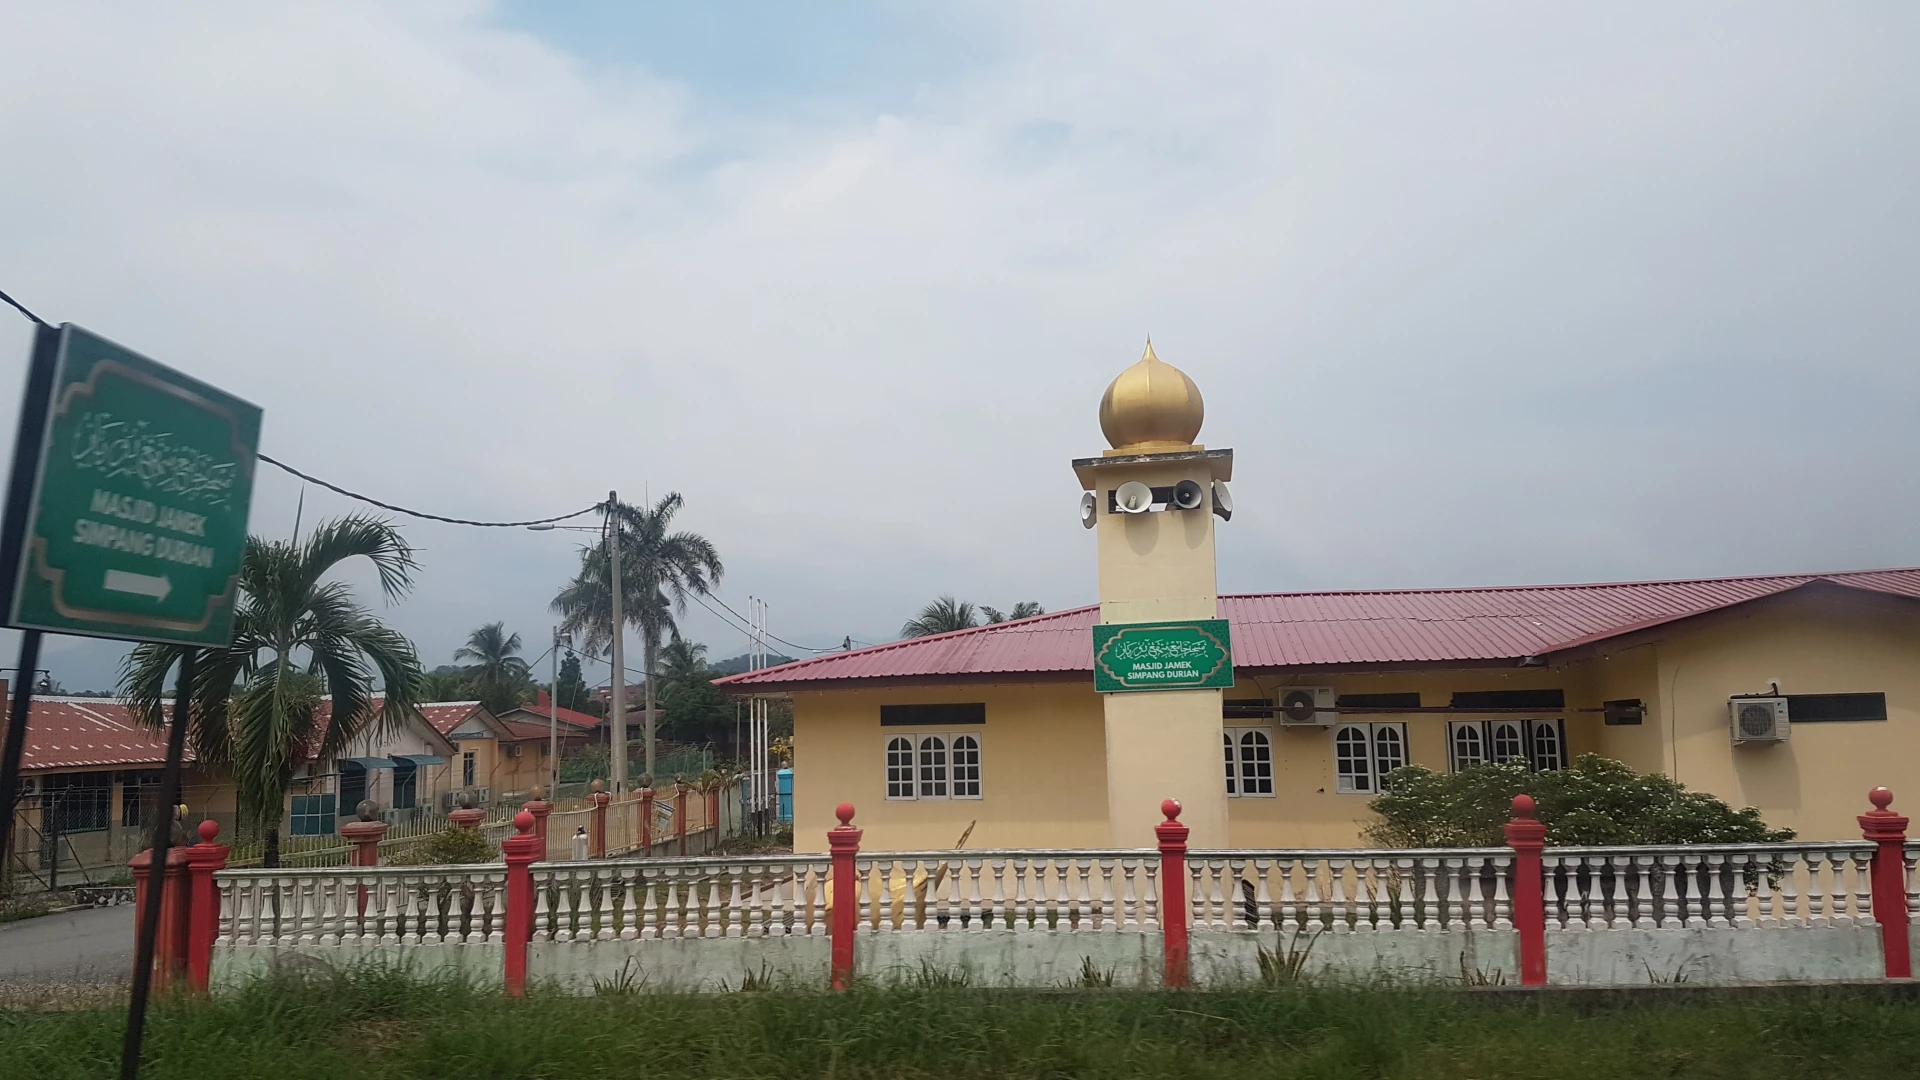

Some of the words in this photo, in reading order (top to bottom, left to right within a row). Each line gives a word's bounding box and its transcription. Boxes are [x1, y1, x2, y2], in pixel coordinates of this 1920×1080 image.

[89, 488, 156, 524] MASJID
[155, 505, 208, 537] JAMEK
[72, 518, 155, 556] SIMPANG
[154, 536, 215, 568] DURIAN
[1127, 671, 1165, 680] SIMPANG
[1166, 669, 1199, 678] DURIAN
[1132, 661, 1162, 670] MASJID
[1164, 661, 1192, 669] JAMEK
